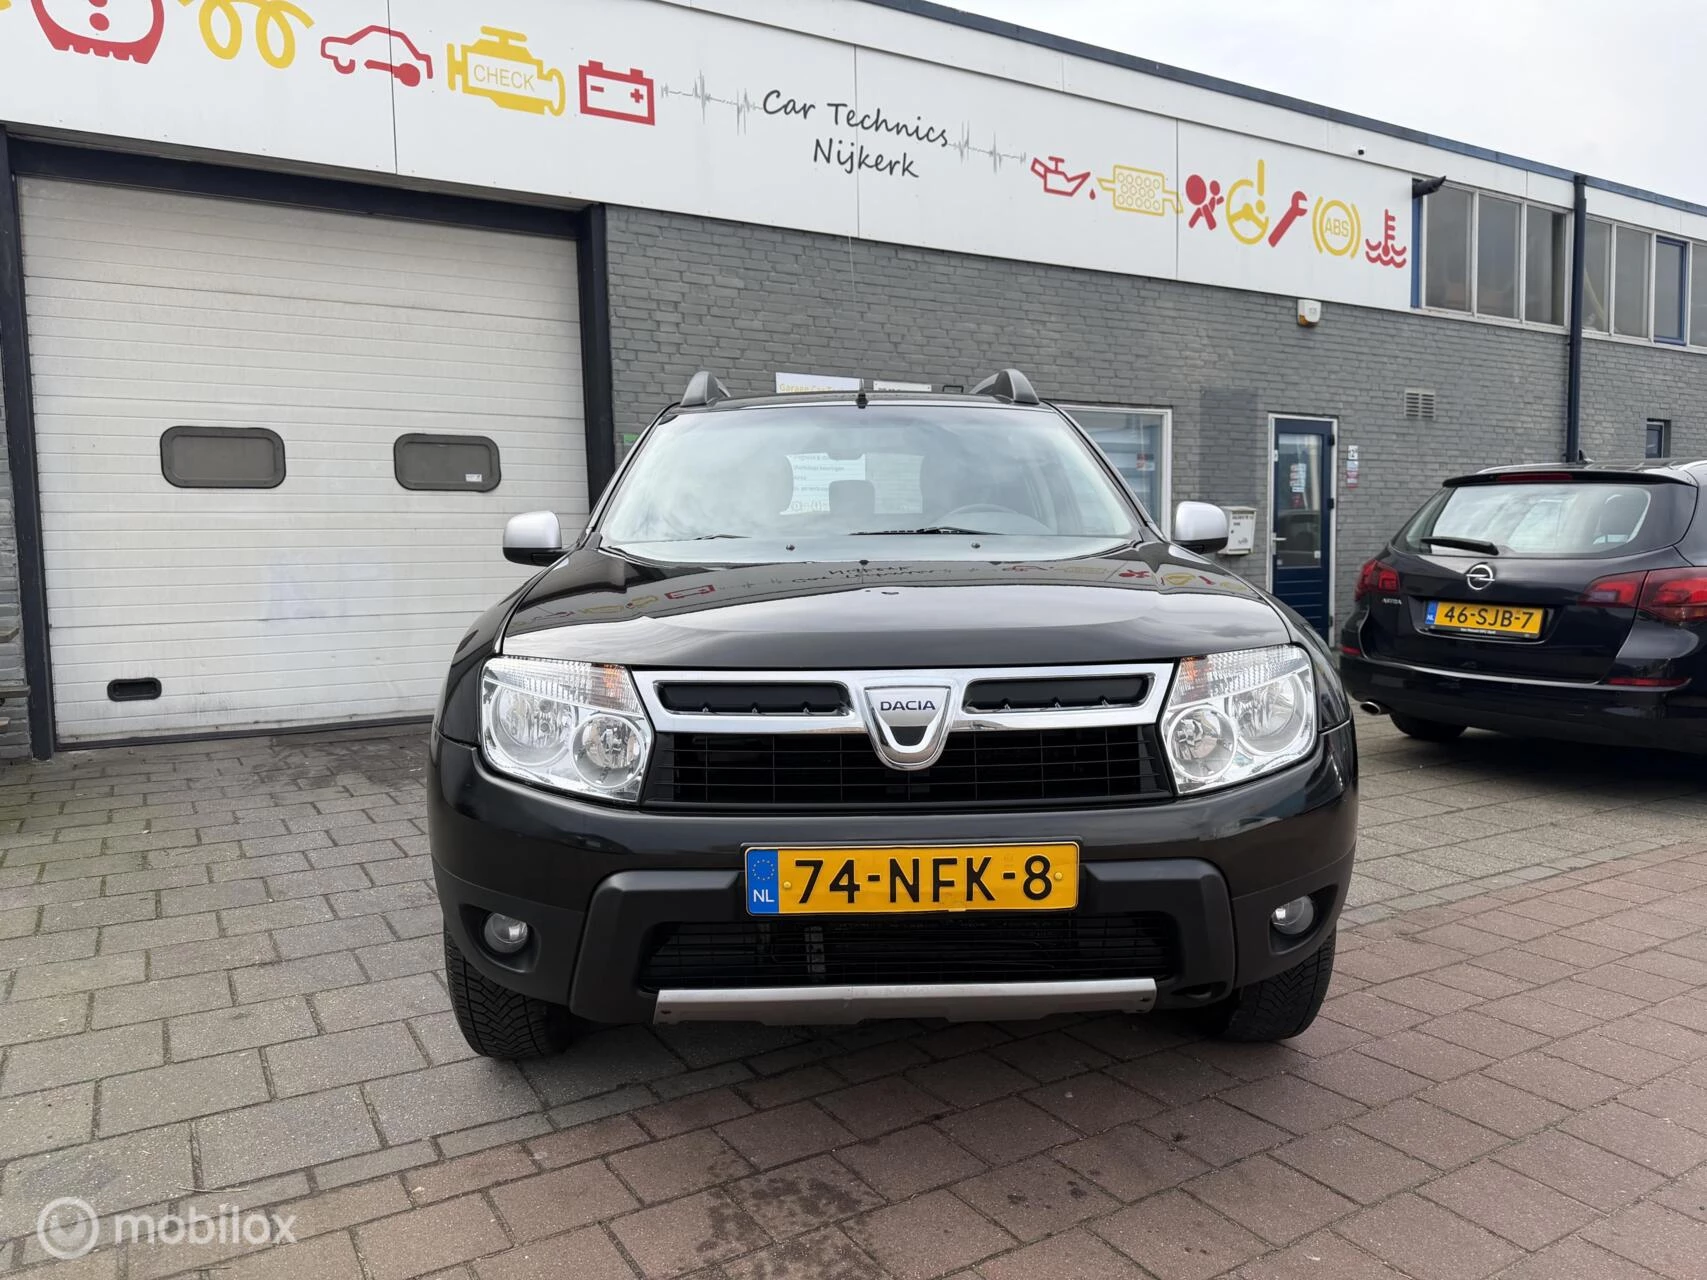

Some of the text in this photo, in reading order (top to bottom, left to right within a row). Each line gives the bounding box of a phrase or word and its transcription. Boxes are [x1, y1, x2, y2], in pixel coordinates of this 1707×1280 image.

[473, 64, 536, 92] CHECK
[763, 89, 949, 148] Car Technics
[813, 137, 919, 178] Nijkerk
[1324, 216, 1350, 238] ABS
[1443, 605, 1534, 629] 46-SJB-7
[880, 700, 936, 711] DACIA
[795, 854, 1052, 904] 74-NFK-8
[753, 889, 775, 903] NL
